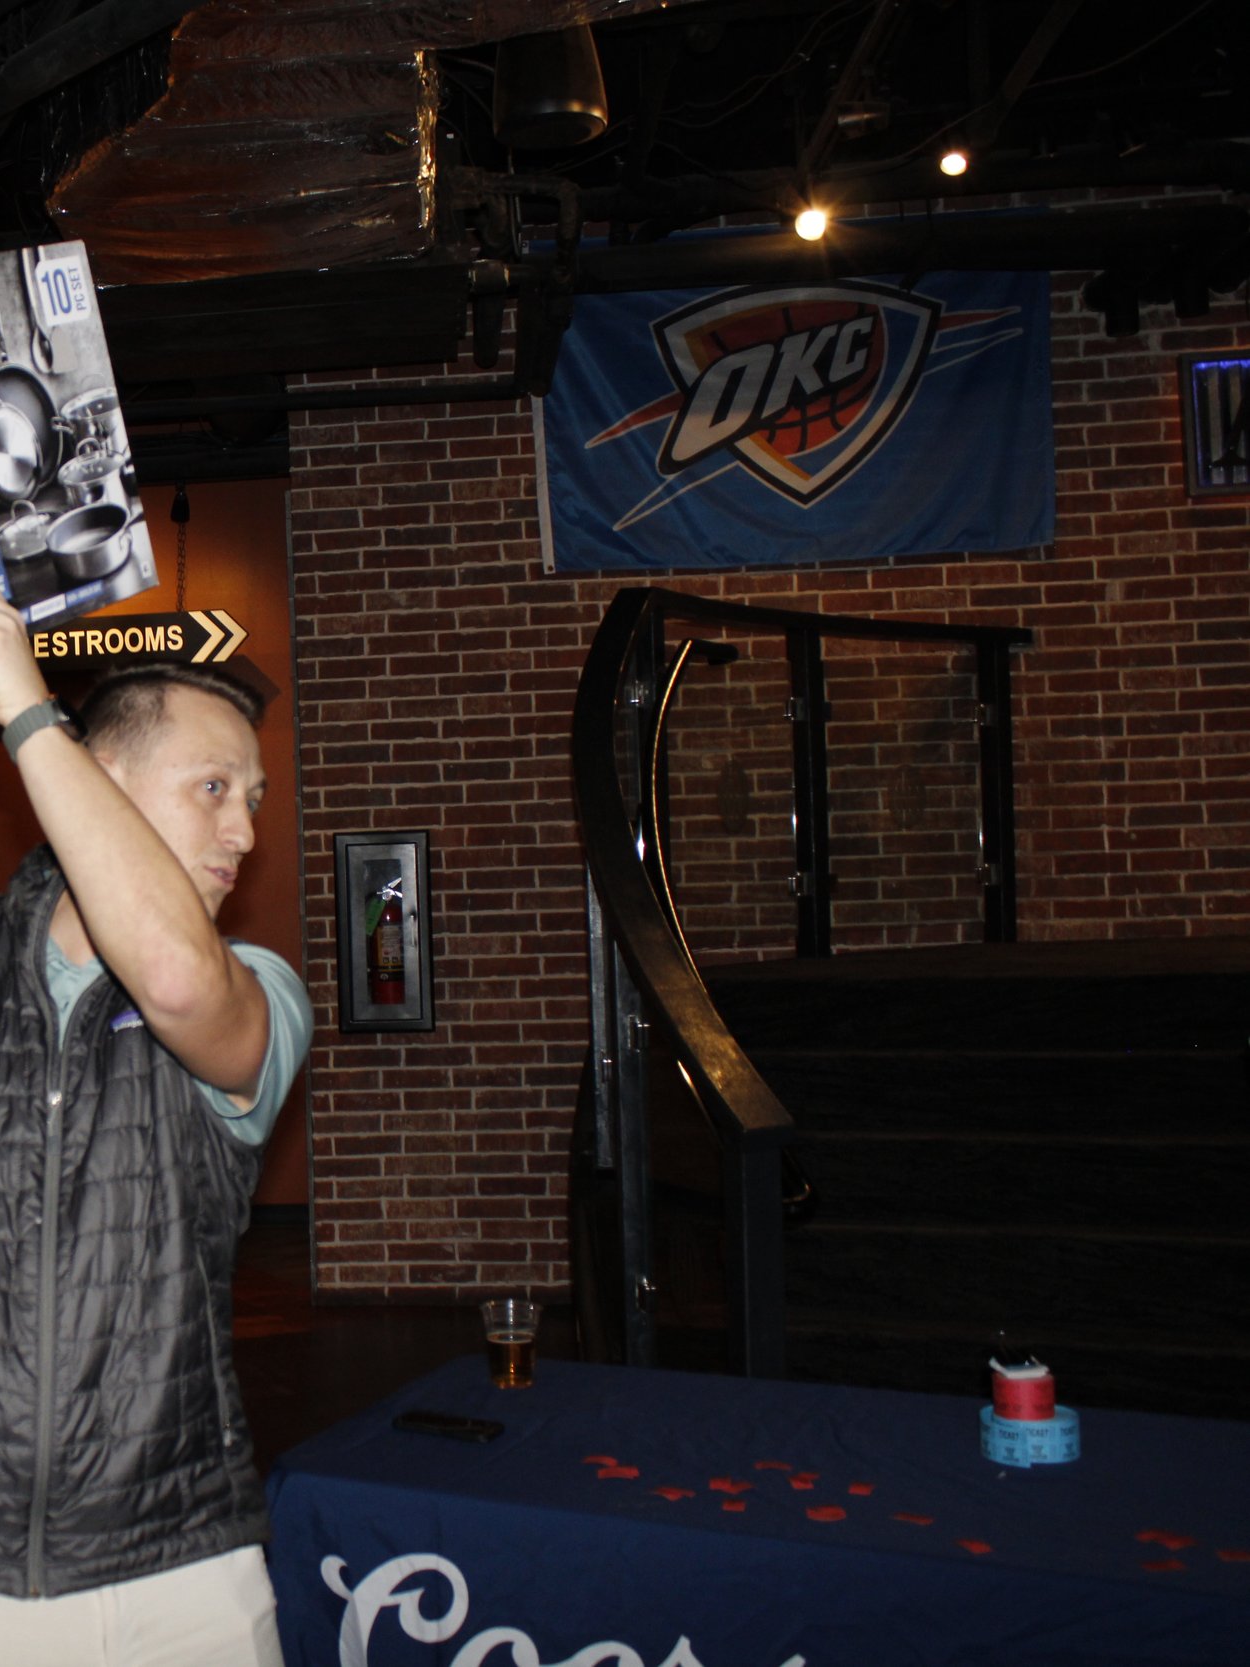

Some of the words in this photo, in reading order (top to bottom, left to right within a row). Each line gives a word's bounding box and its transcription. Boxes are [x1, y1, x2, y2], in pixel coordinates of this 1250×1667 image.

[41, 268, 72, 317] 10
[74, 266, 85, 290] SET
[76, 292, 88, 311] PC
[669, 316, 874, 463] OKC
[34, 624, 184, 658] ESTROOMS
